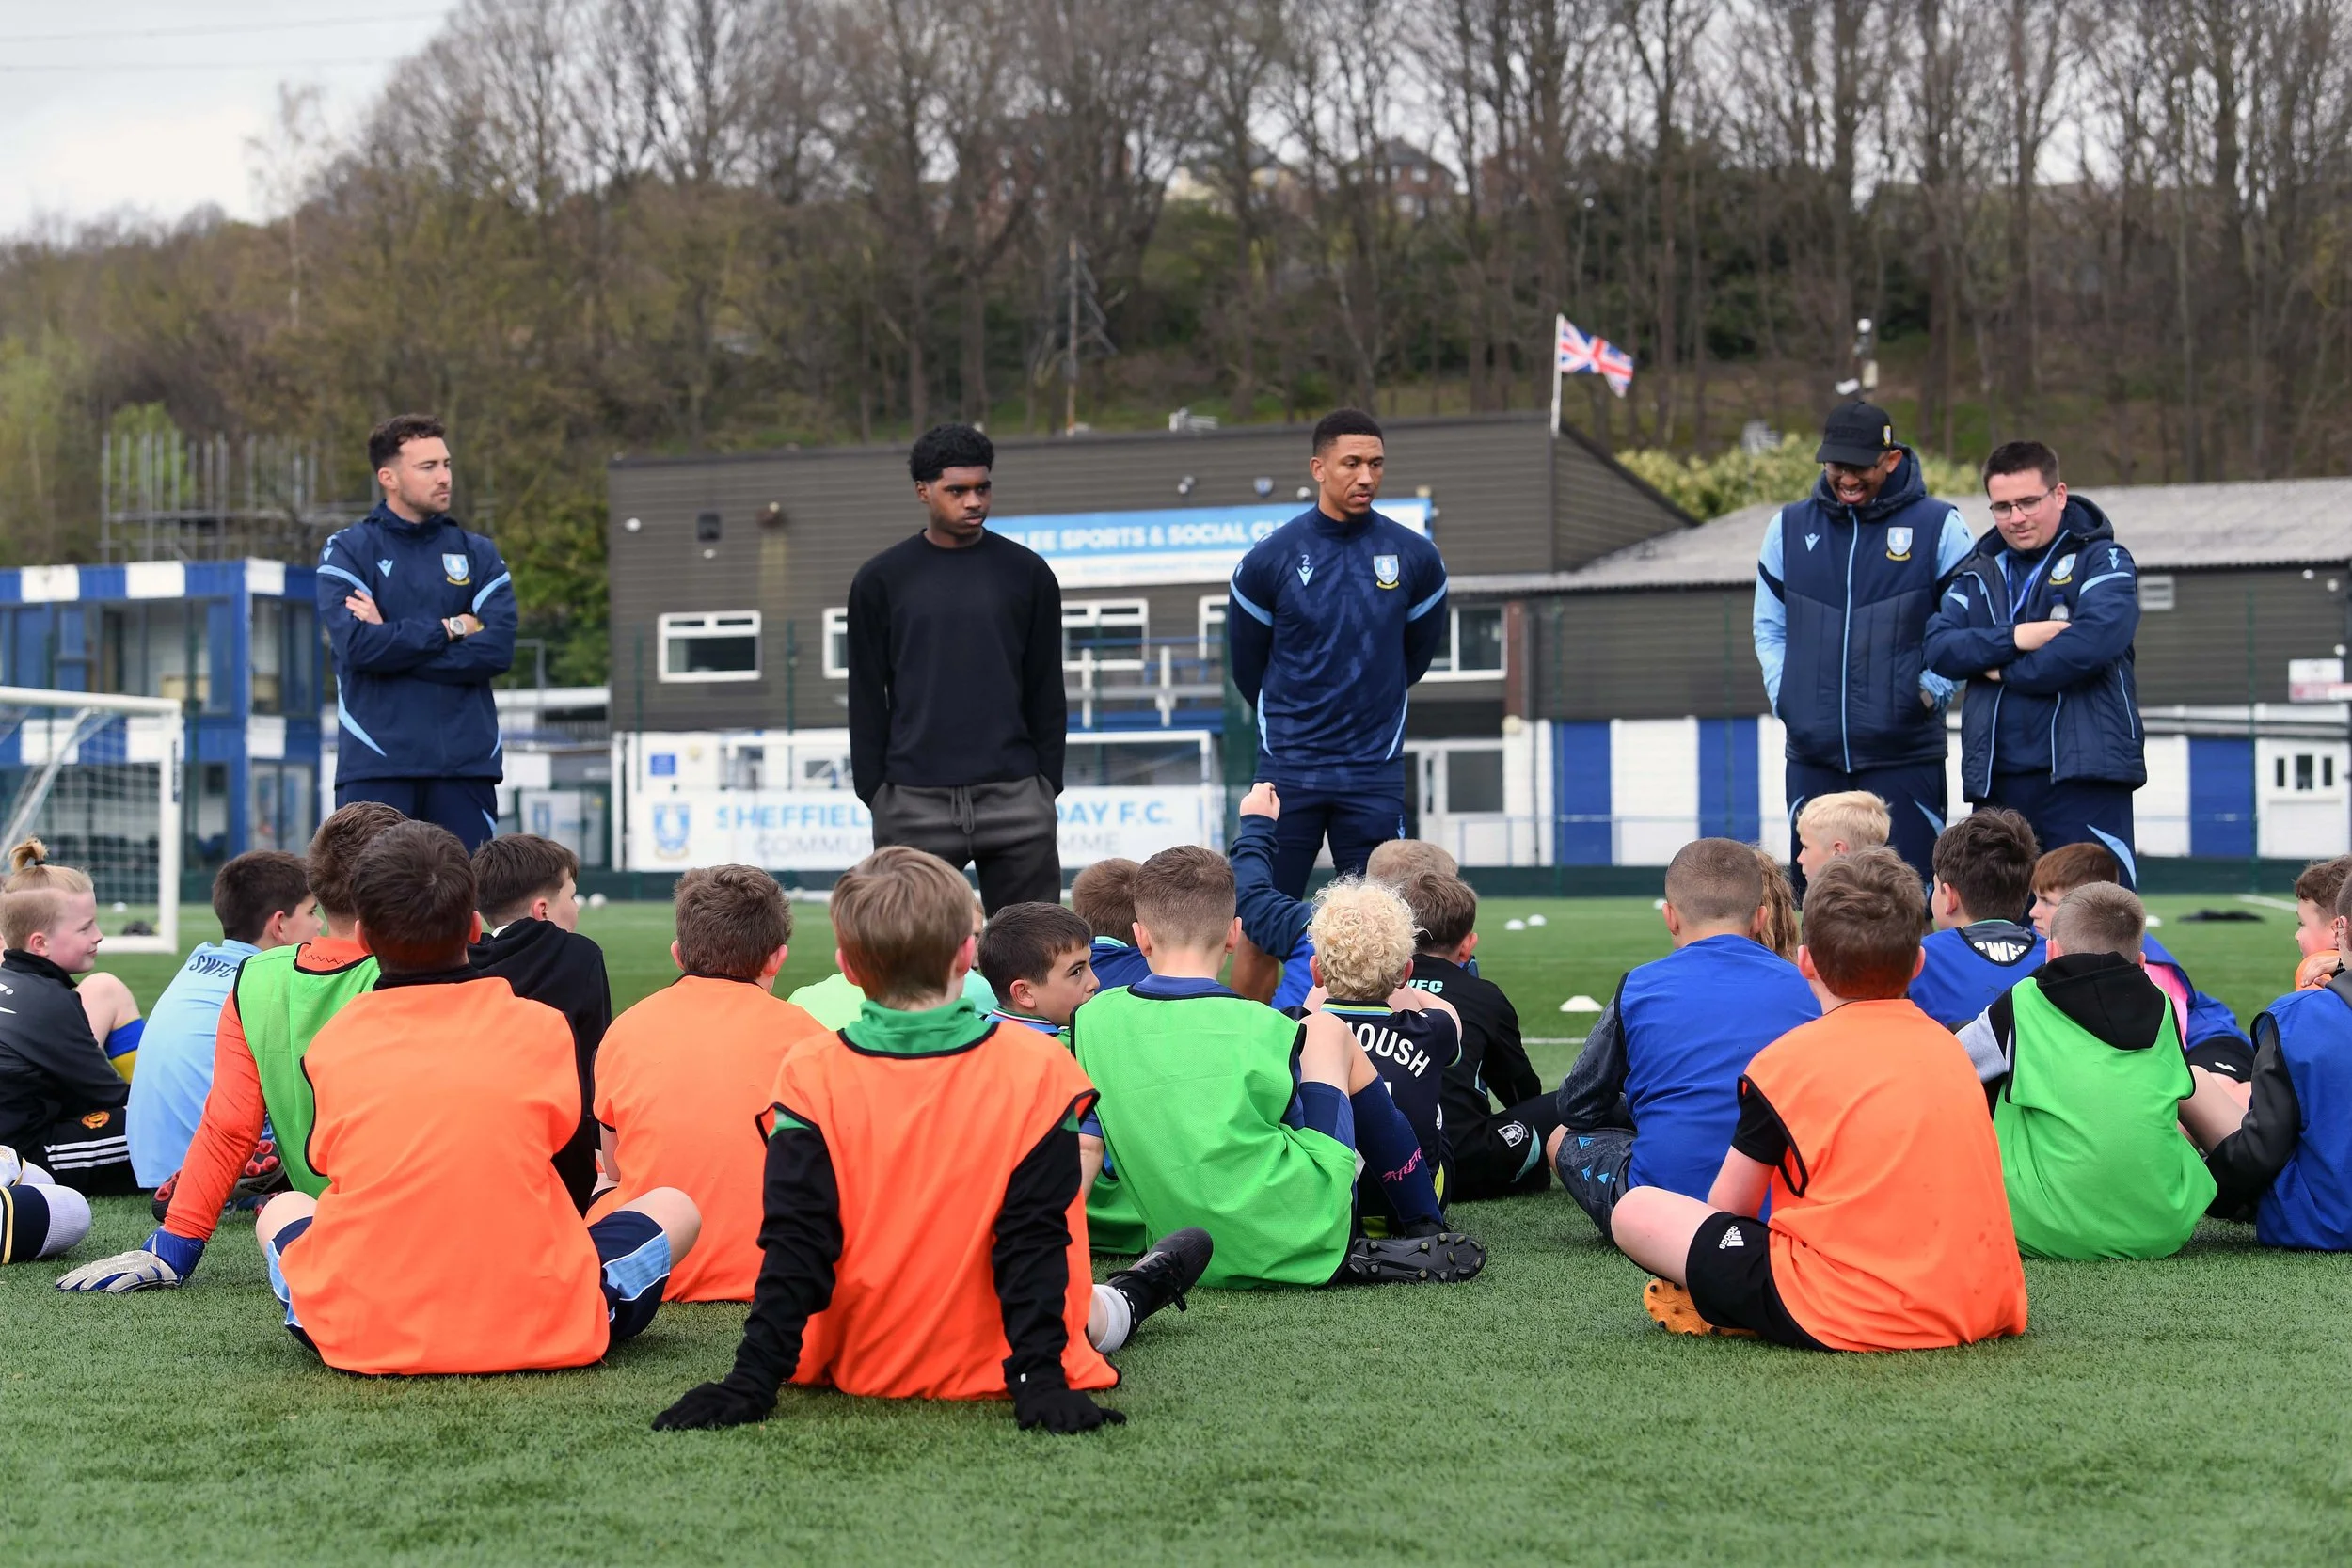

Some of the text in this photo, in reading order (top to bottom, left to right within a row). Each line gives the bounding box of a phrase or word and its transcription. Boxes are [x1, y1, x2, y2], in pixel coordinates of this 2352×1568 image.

[1060, 526, 1146, 550] SPORTS
[1149, 524, 1165, 546] &
[1168, 521, 1248, 546] SOCIAL
[1301, 554, 1311, 566] 2
[716, 803, 871, 829] SHEFFIEL
[1119, 801, 1172, 825] F.C.
[188, 955, 238, 977] SWFC
[1346, 1022, 1431, 1078] OUSH
